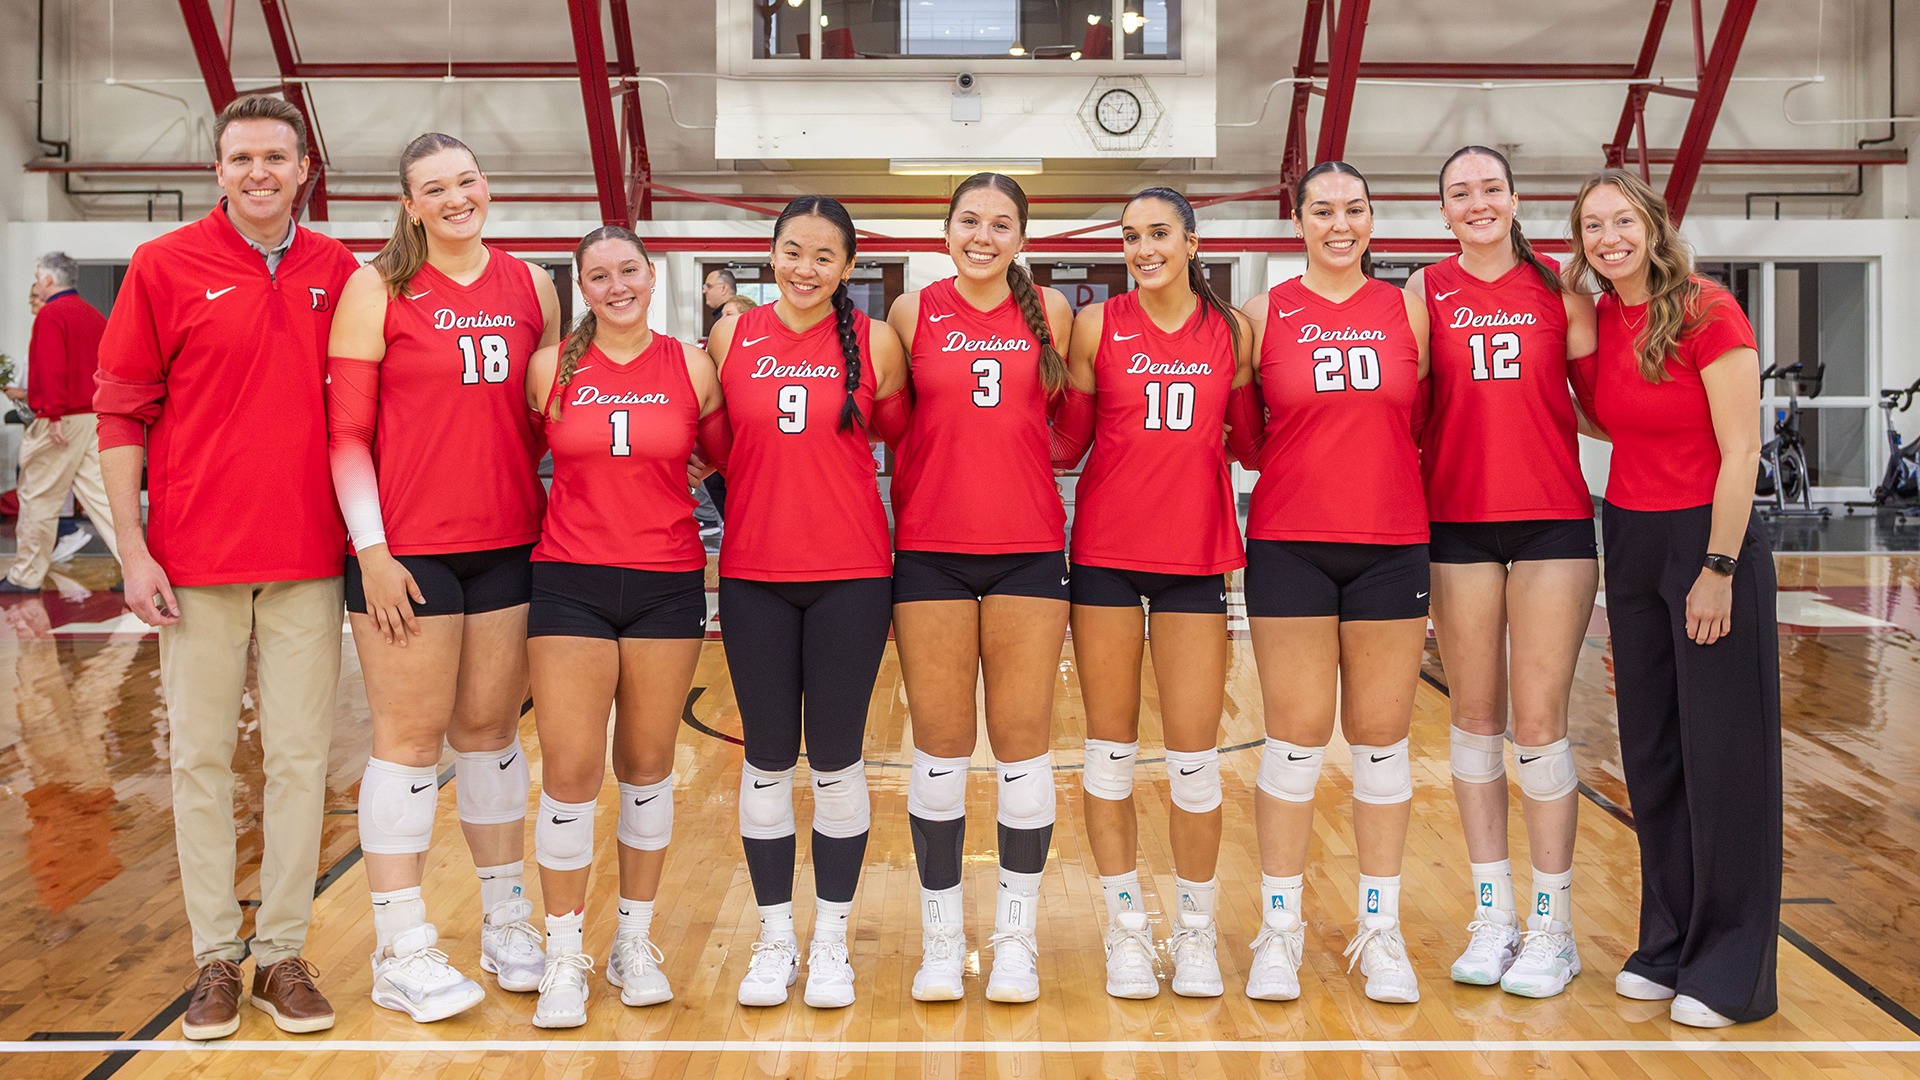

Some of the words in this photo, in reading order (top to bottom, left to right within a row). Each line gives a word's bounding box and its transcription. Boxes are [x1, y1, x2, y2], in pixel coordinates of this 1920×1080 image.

[308, 286, 330, 312] D
[434, 309, 515, 330] Denison
[1450, 307, 1536, 328] Denison
[942, 331, 1030, 352] Denison
[1297, 324, 1386, 344] Denison
[458, 334, 510, 385] 18
[751, 356, 839, 378] Denison
[1127, 353, 1212, 375] Denison
[1312, 346, 1380, 393] 20
[1468, 332, 1521, 381] 12
[572, 386, 669, 405] Denison
[971, 358, 1001, 408] 3
[778, 385, 808, 434] 9
[1144, 381, 1195, 431] 10
[609, 410, 631, 456] 1
